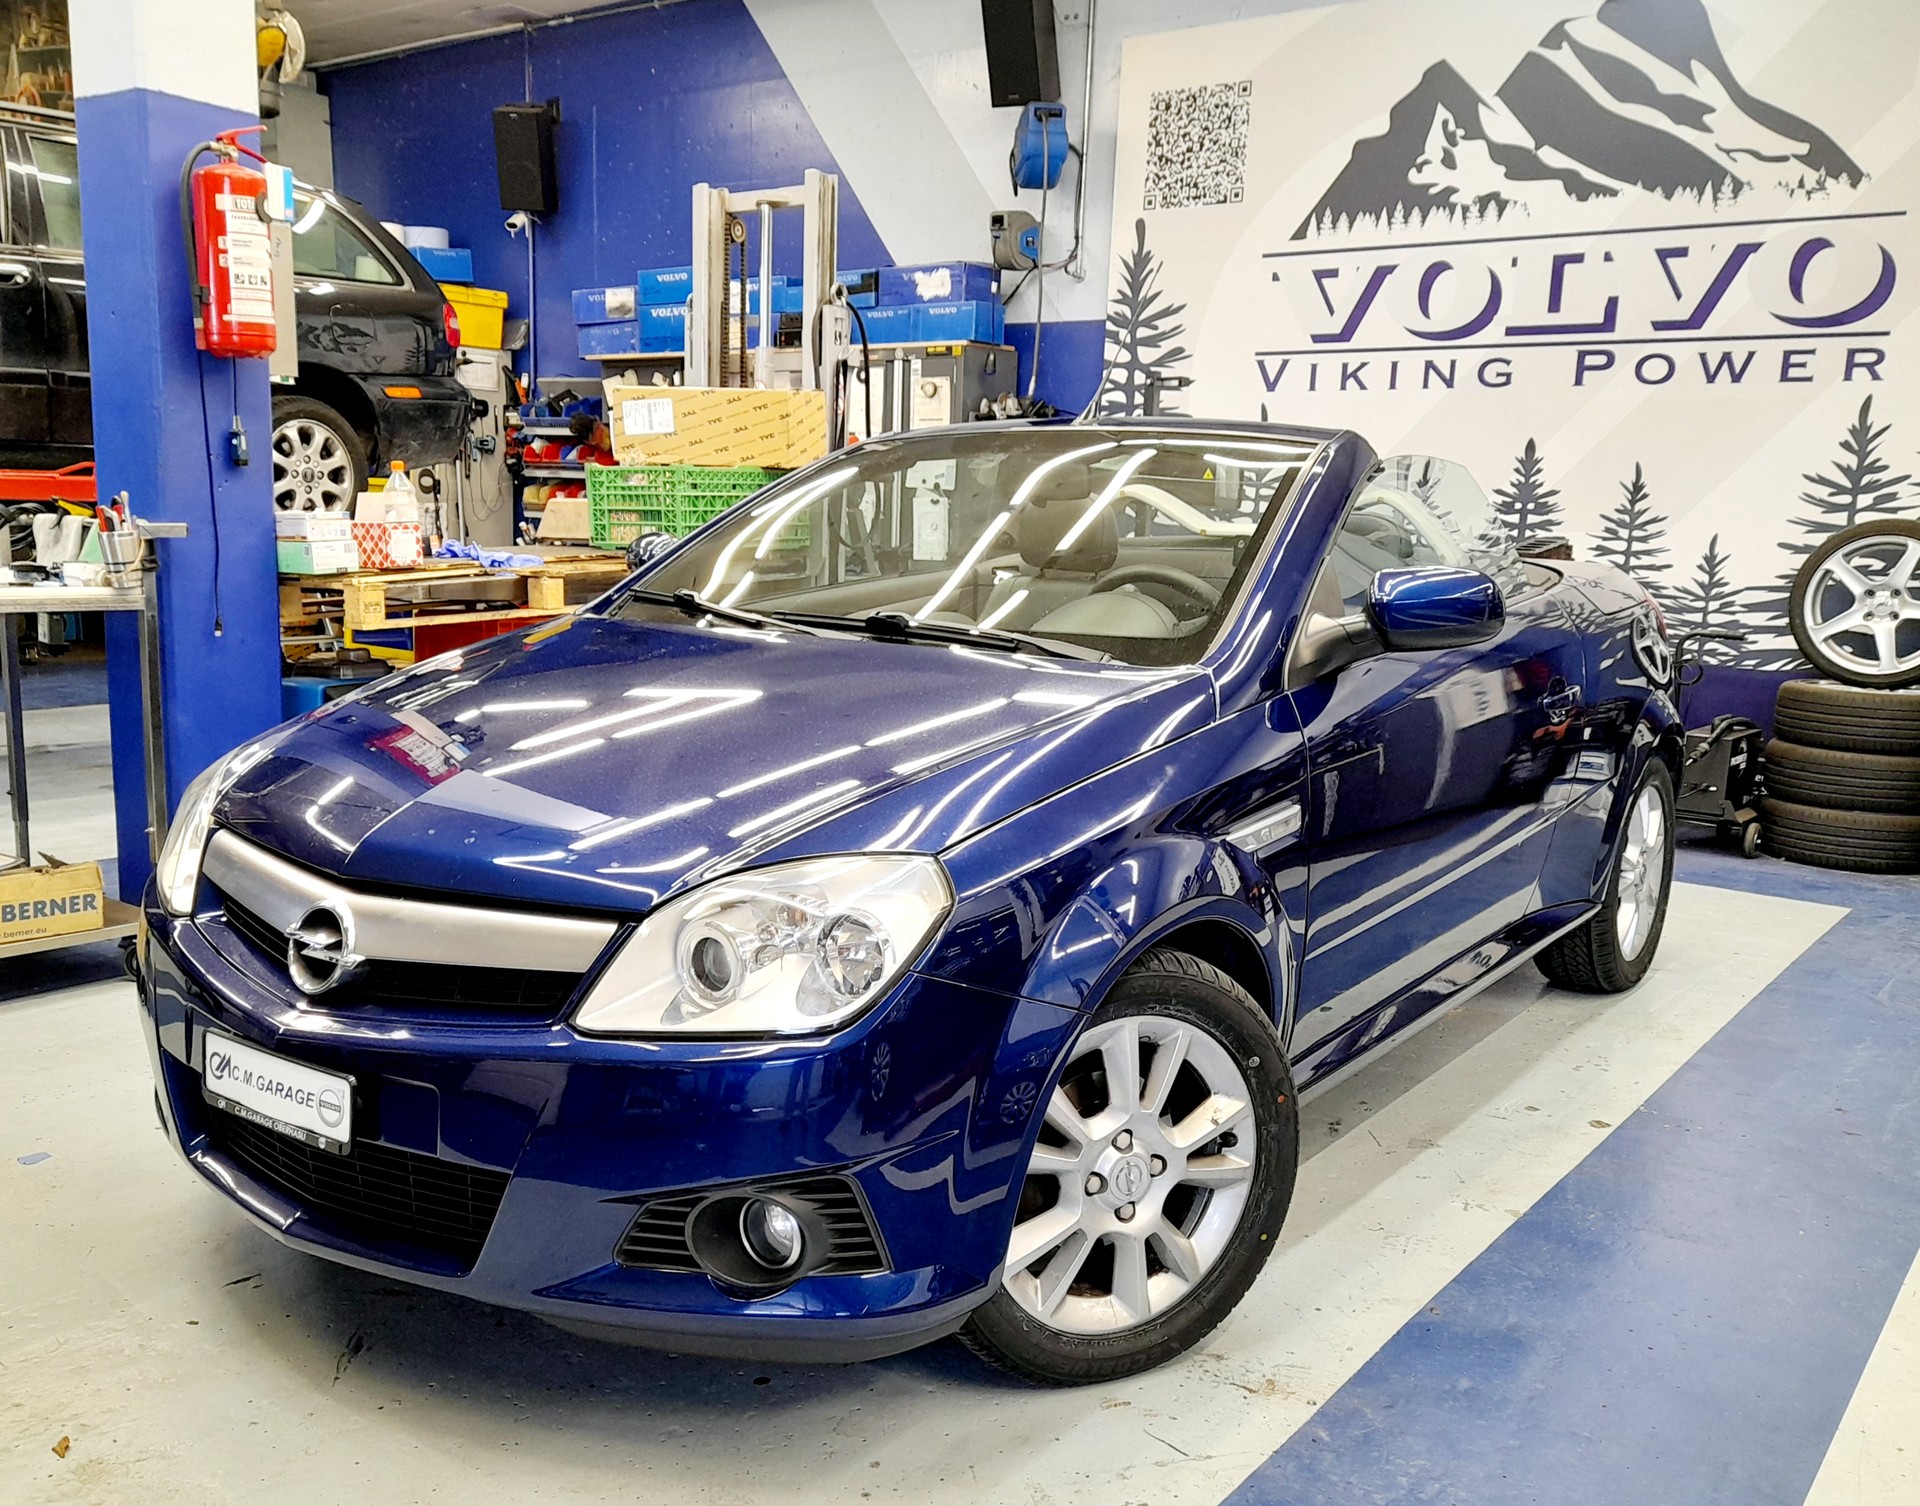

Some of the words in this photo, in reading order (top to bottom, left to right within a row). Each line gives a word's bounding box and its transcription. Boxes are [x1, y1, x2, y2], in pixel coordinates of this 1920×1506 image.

[656, 272, 688, 282] VOLVO
[836, 273, 858, 282] OLVO
[1268, 232, 1897, 343] VOLVO
[587, 294, 606, 302] VOL
[650, 306, 688, 317] VOLVO
[867, 310, 894, 319] VOLVO
[928, 306, 957, 316] VOLVO
[1257, 357, 1513, 393] VIKING
[1572, 348, 1886, 387] POWER
[1, 893, 97, 923] BERNER
[0, 927, 47, 939] .berner.eu
[232, 1065, 316, 1109] C.M.GARAGE
[319, 1100, 341, 1113] VOLVO
[234, 1106, 273, 1128] C.M.GARAGE
